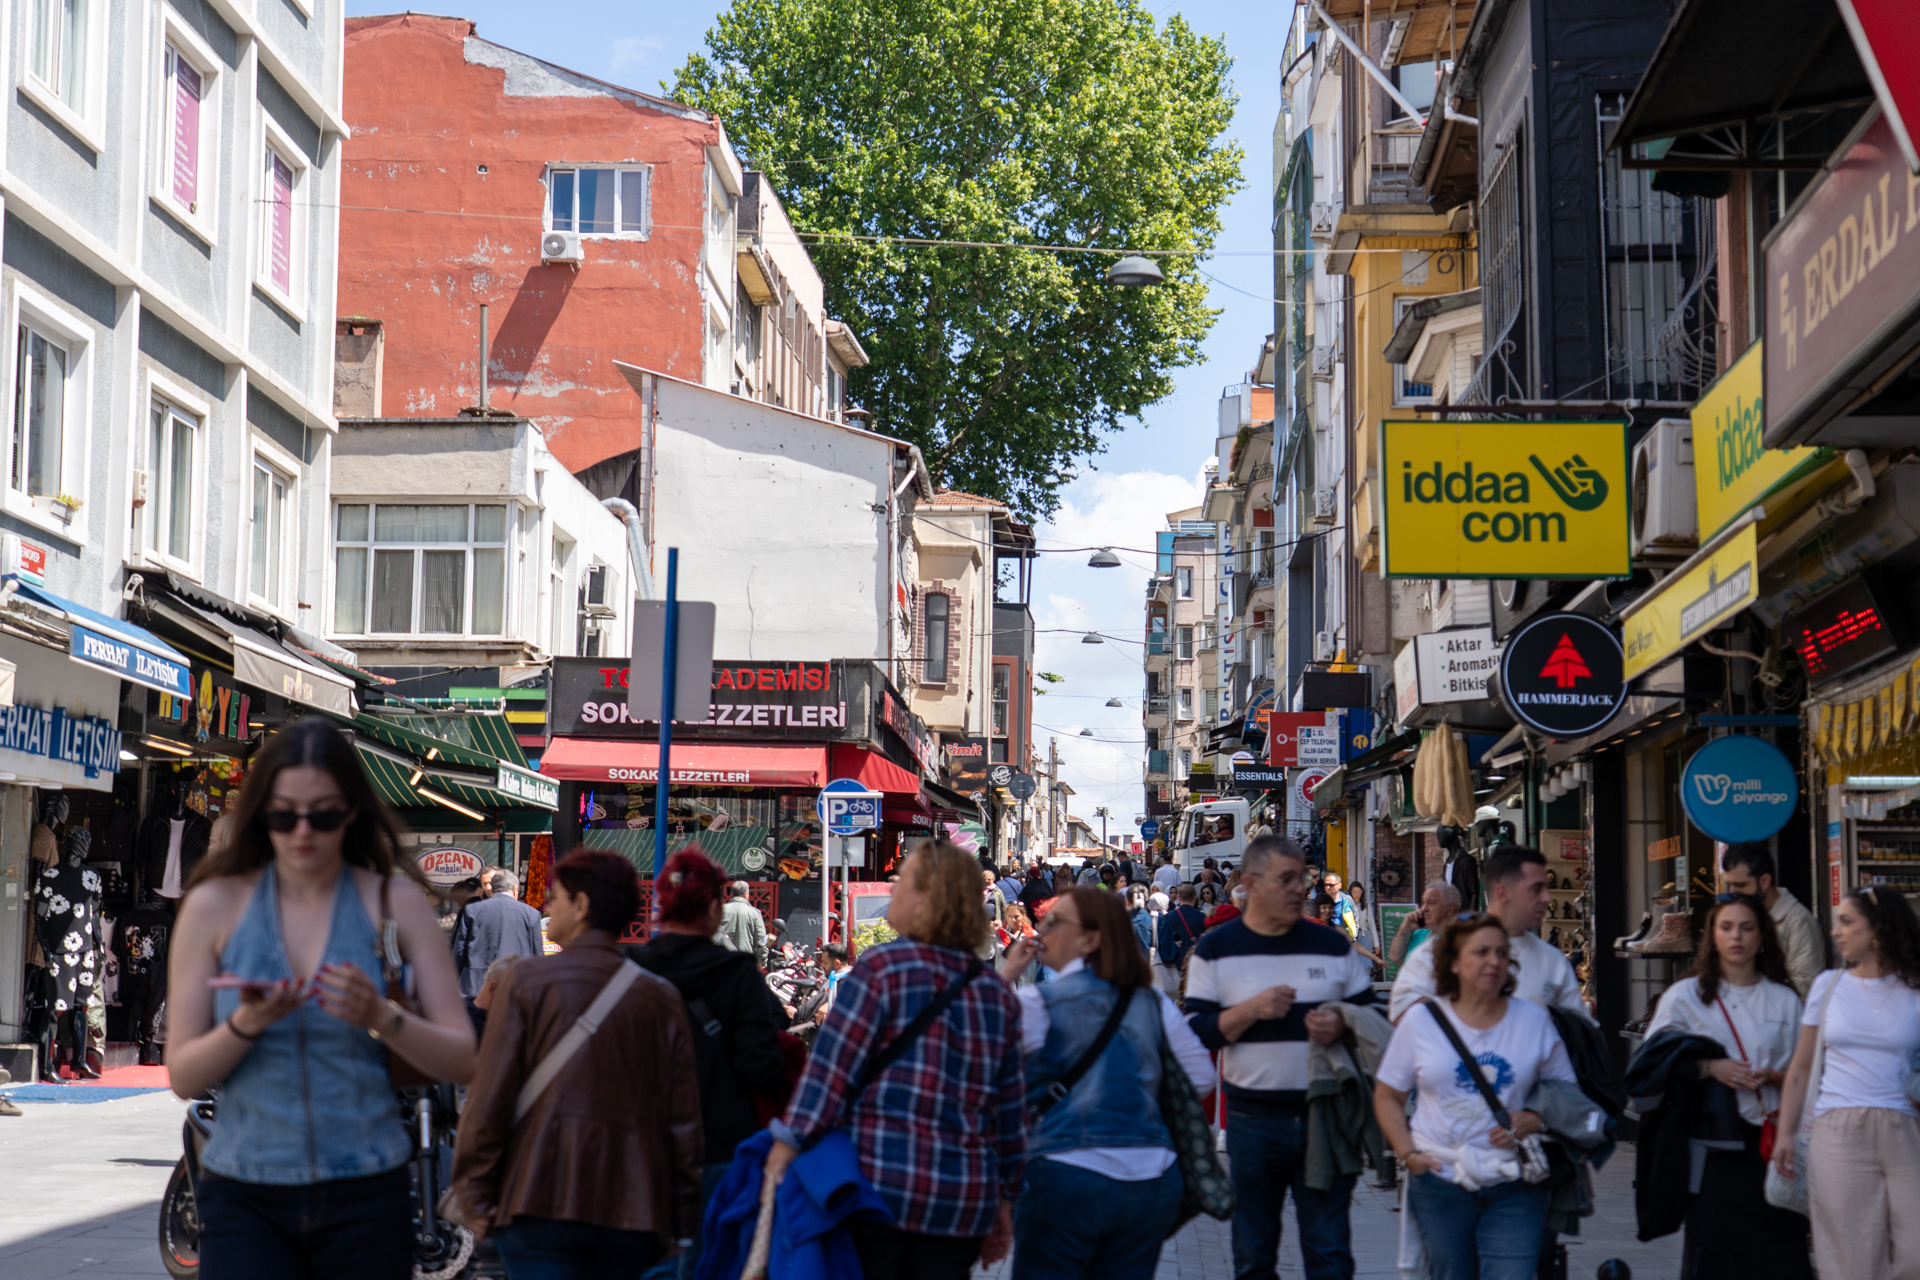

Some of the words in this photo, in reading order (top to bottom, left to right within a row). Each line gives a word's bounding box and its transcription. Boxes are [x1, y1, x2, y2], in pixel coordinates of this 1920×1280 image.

[1803, 170, 1900, 339] ERDAL
[1403, 460, 1531, 504] iddaa
[1462, 510, 1567, 543] com
[1446, 638, 1482, 653] Aktar
[83, 634, 130, 668] FERHAT
[135, 650, 180, 687] İLETİŞİM
[711, 662, 830, 692] ADEMİSİ
[1517, 692, 1614, 707] HAMMERJACK
[217, 686, 251, 741] YEK
[684, 701, 846, 728] EZZETLERİ
[58, 707, 123, 778] İLETİŞİM
[608, 768, 658, 781] SOKAK
[670, 769, 750, 784] LEZZETLERİ
[1235, 771, 1284, 781] ESSENTIALS
[1732, 779, 1761, 790] milli
[1732, 791, 1789, 804] piyango
[830, 799, 848, 824] P
[424, 852, 474, 872] ÖZCAN
[434, 863, 463, 874] Ambalaj
